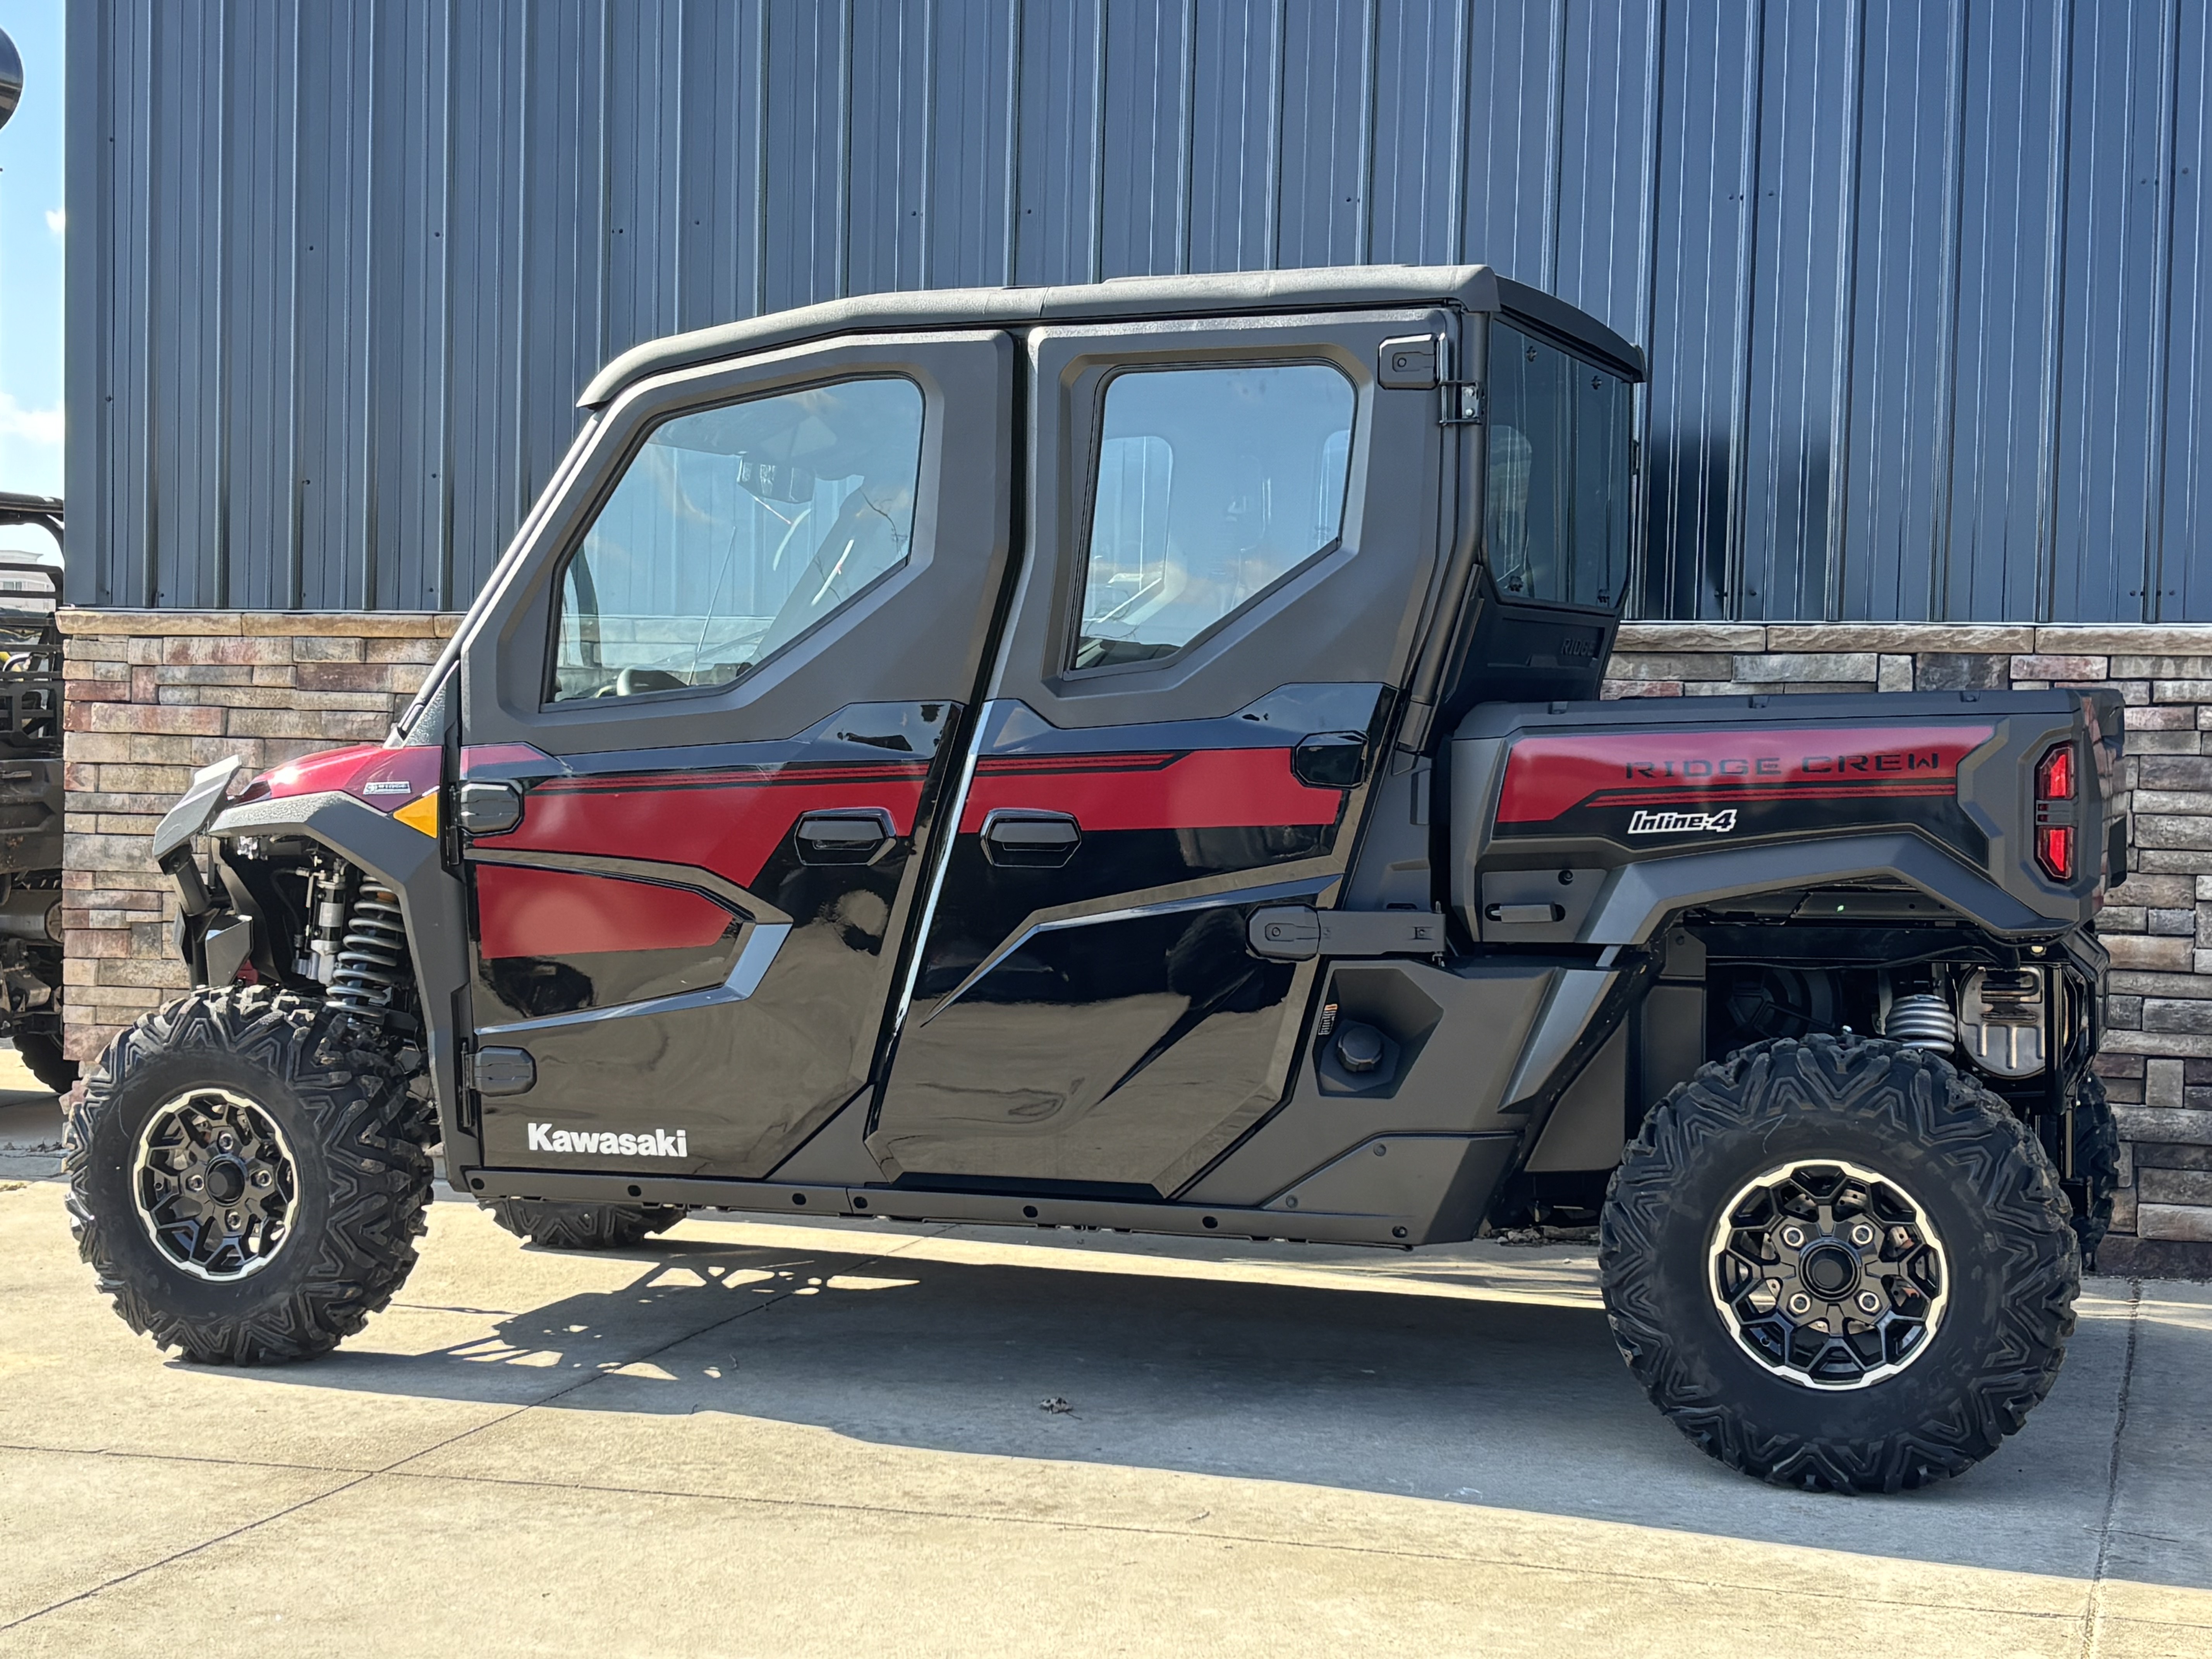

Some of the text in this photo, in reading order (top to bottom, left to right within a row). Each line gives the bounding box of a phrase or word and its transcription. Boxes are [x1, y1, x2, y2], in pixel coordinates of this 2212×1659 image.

[1626, 753, 1939, 779] RIDGE CREW
[1629, 810, 1735, 832] Inline-4
[527, 1123, 687, 1157] Kawasaki
